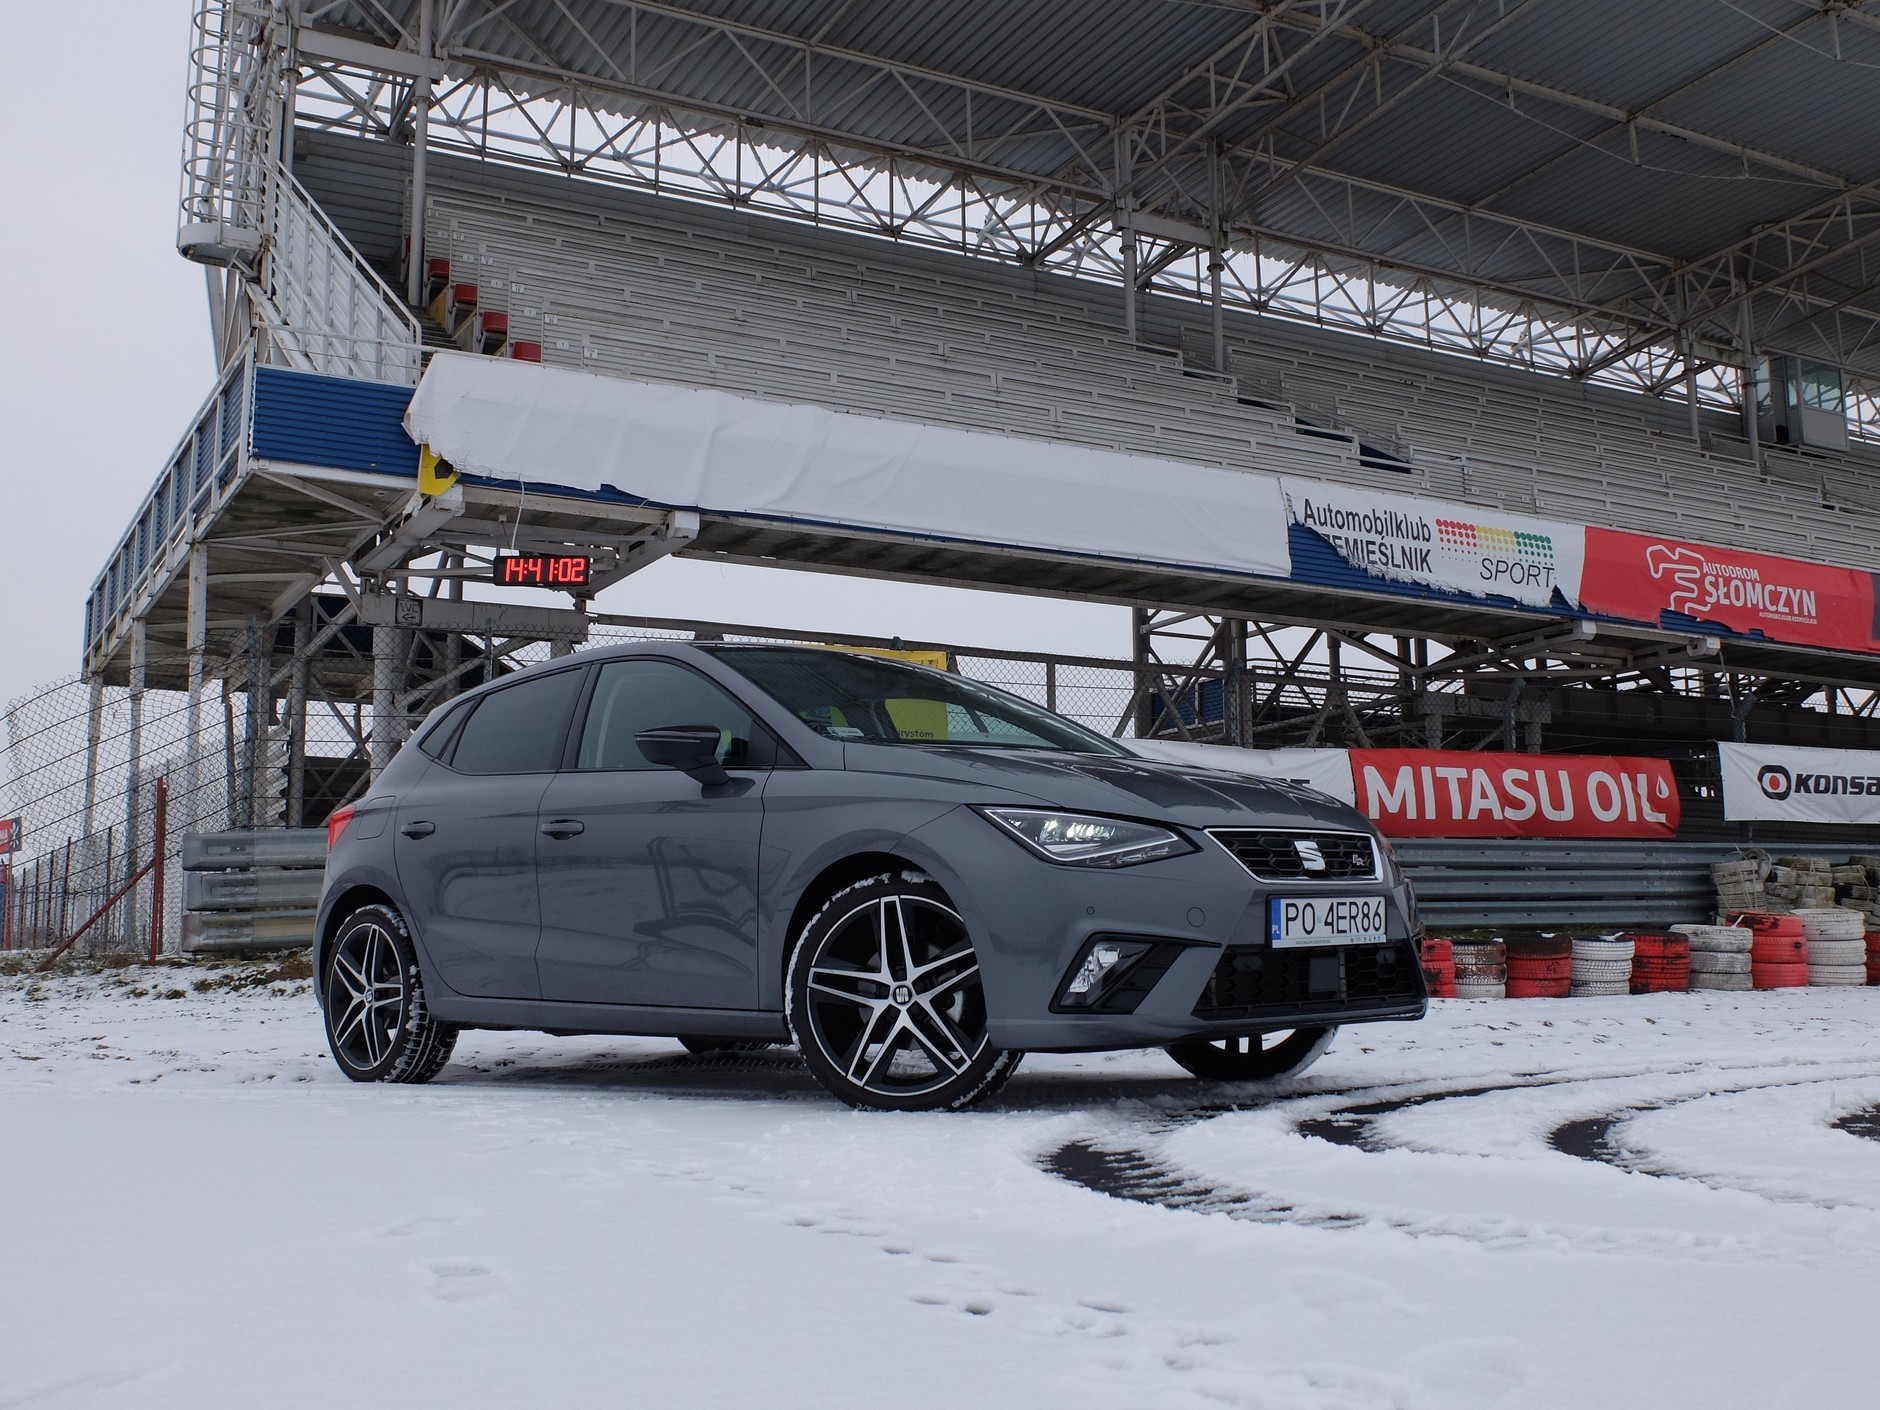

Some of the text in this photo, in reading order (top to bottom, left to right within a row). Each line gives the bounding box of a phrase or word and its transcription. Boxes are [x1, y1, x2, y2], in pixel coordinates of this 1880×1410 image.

[1303, 498, 1432, 543] Automobilklub
[505, 558, 585, 582] 14:41:02
[1320, 533, 1433, 574] EMIEŚLNIK
[1702, 561, 1760, 582] AUTODROM
[1479, 557, 1555, 588] SPORT
[1704, 575, 1818, 617] SŁOMCZYN
[1362, 765, 1667, 824] MITASU OIL
[1271, 924, 1281, 935] PL
